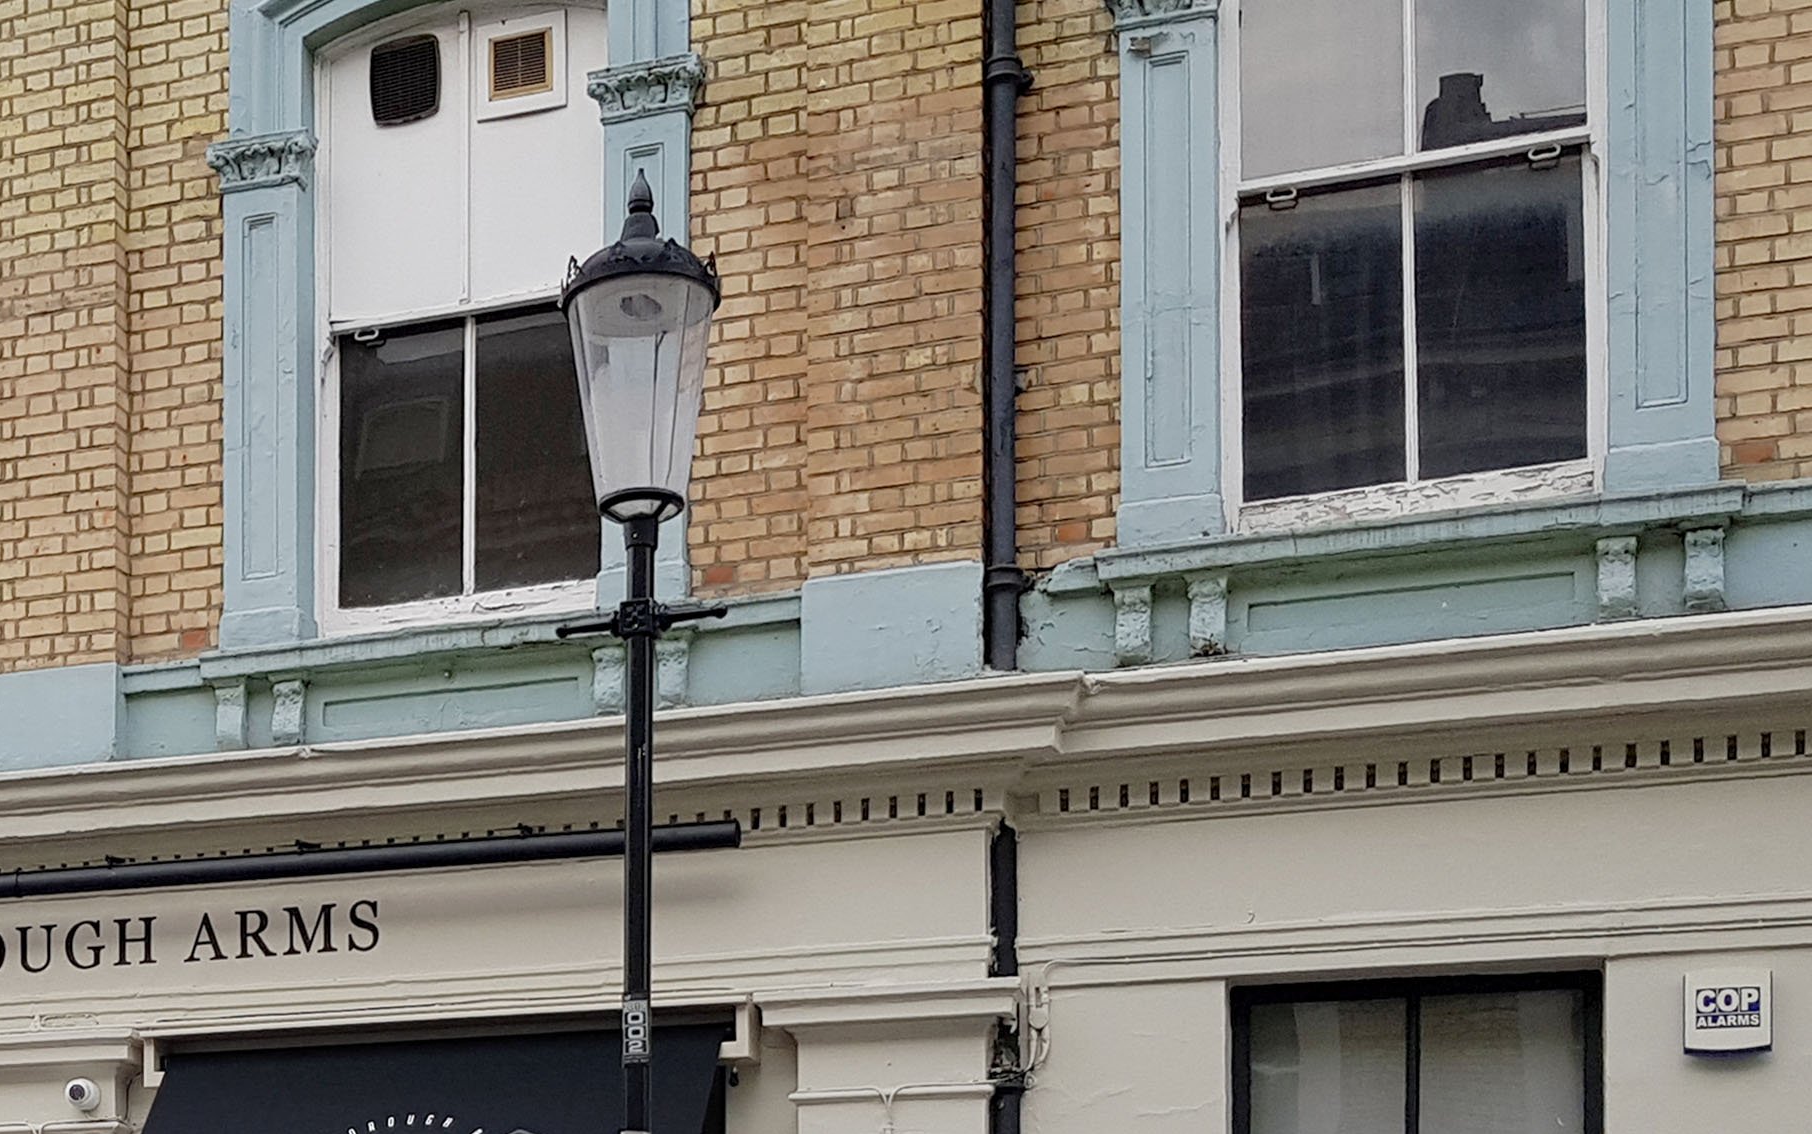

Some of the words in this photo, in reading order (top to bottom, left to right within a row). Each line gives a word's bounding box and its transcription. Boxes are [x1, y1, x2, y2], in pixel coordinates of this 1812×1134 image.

[183, 899, 381, 963] ARMS
[1696, 987, 1760, 1013] COP
[626, 1011, 645, 1053] 002
[1696, 1014, 1760, 1028] ALARMS
